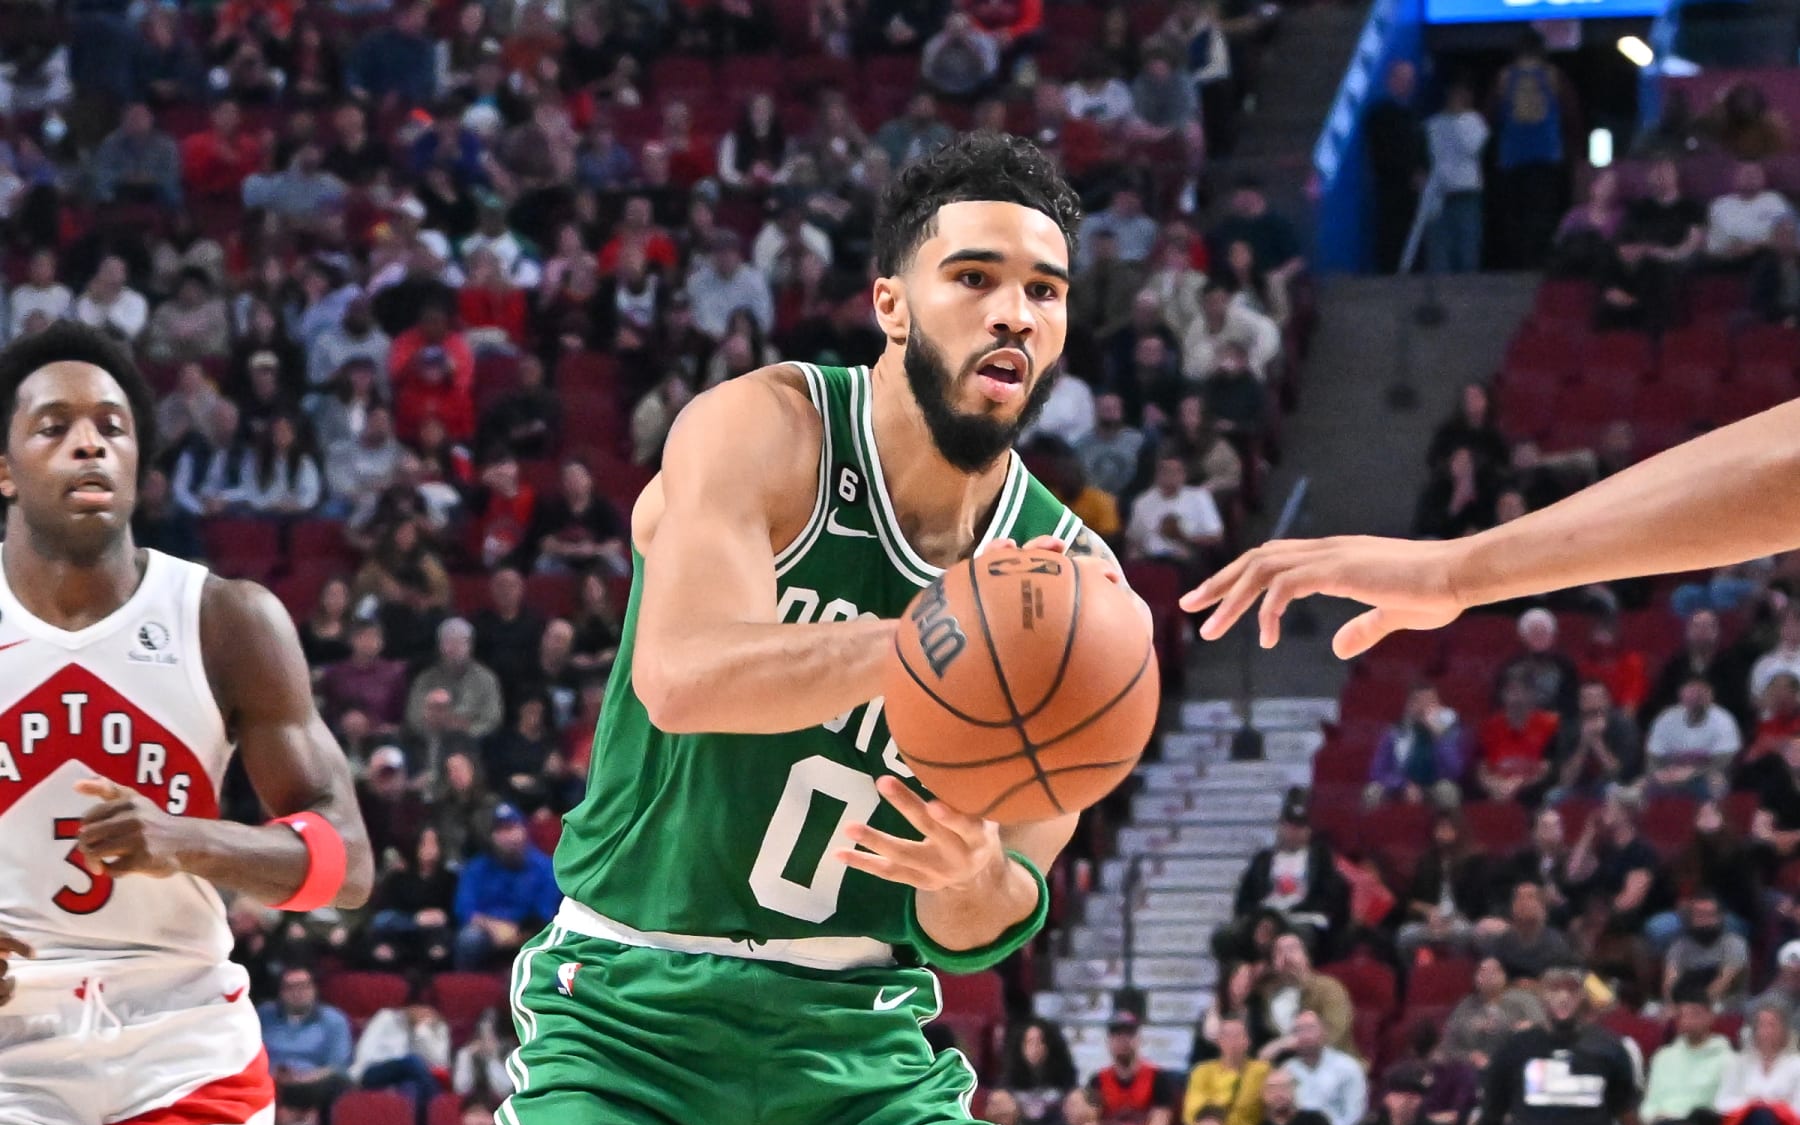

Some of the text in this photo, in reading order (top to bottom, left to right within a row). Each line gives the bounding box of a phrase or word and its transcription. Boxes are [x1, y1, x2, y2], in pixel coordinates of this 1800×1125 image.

[839, 467, 859, 502] 6
[52, 817, 114, 914] 3
[749, 754, 881, 924] 0
